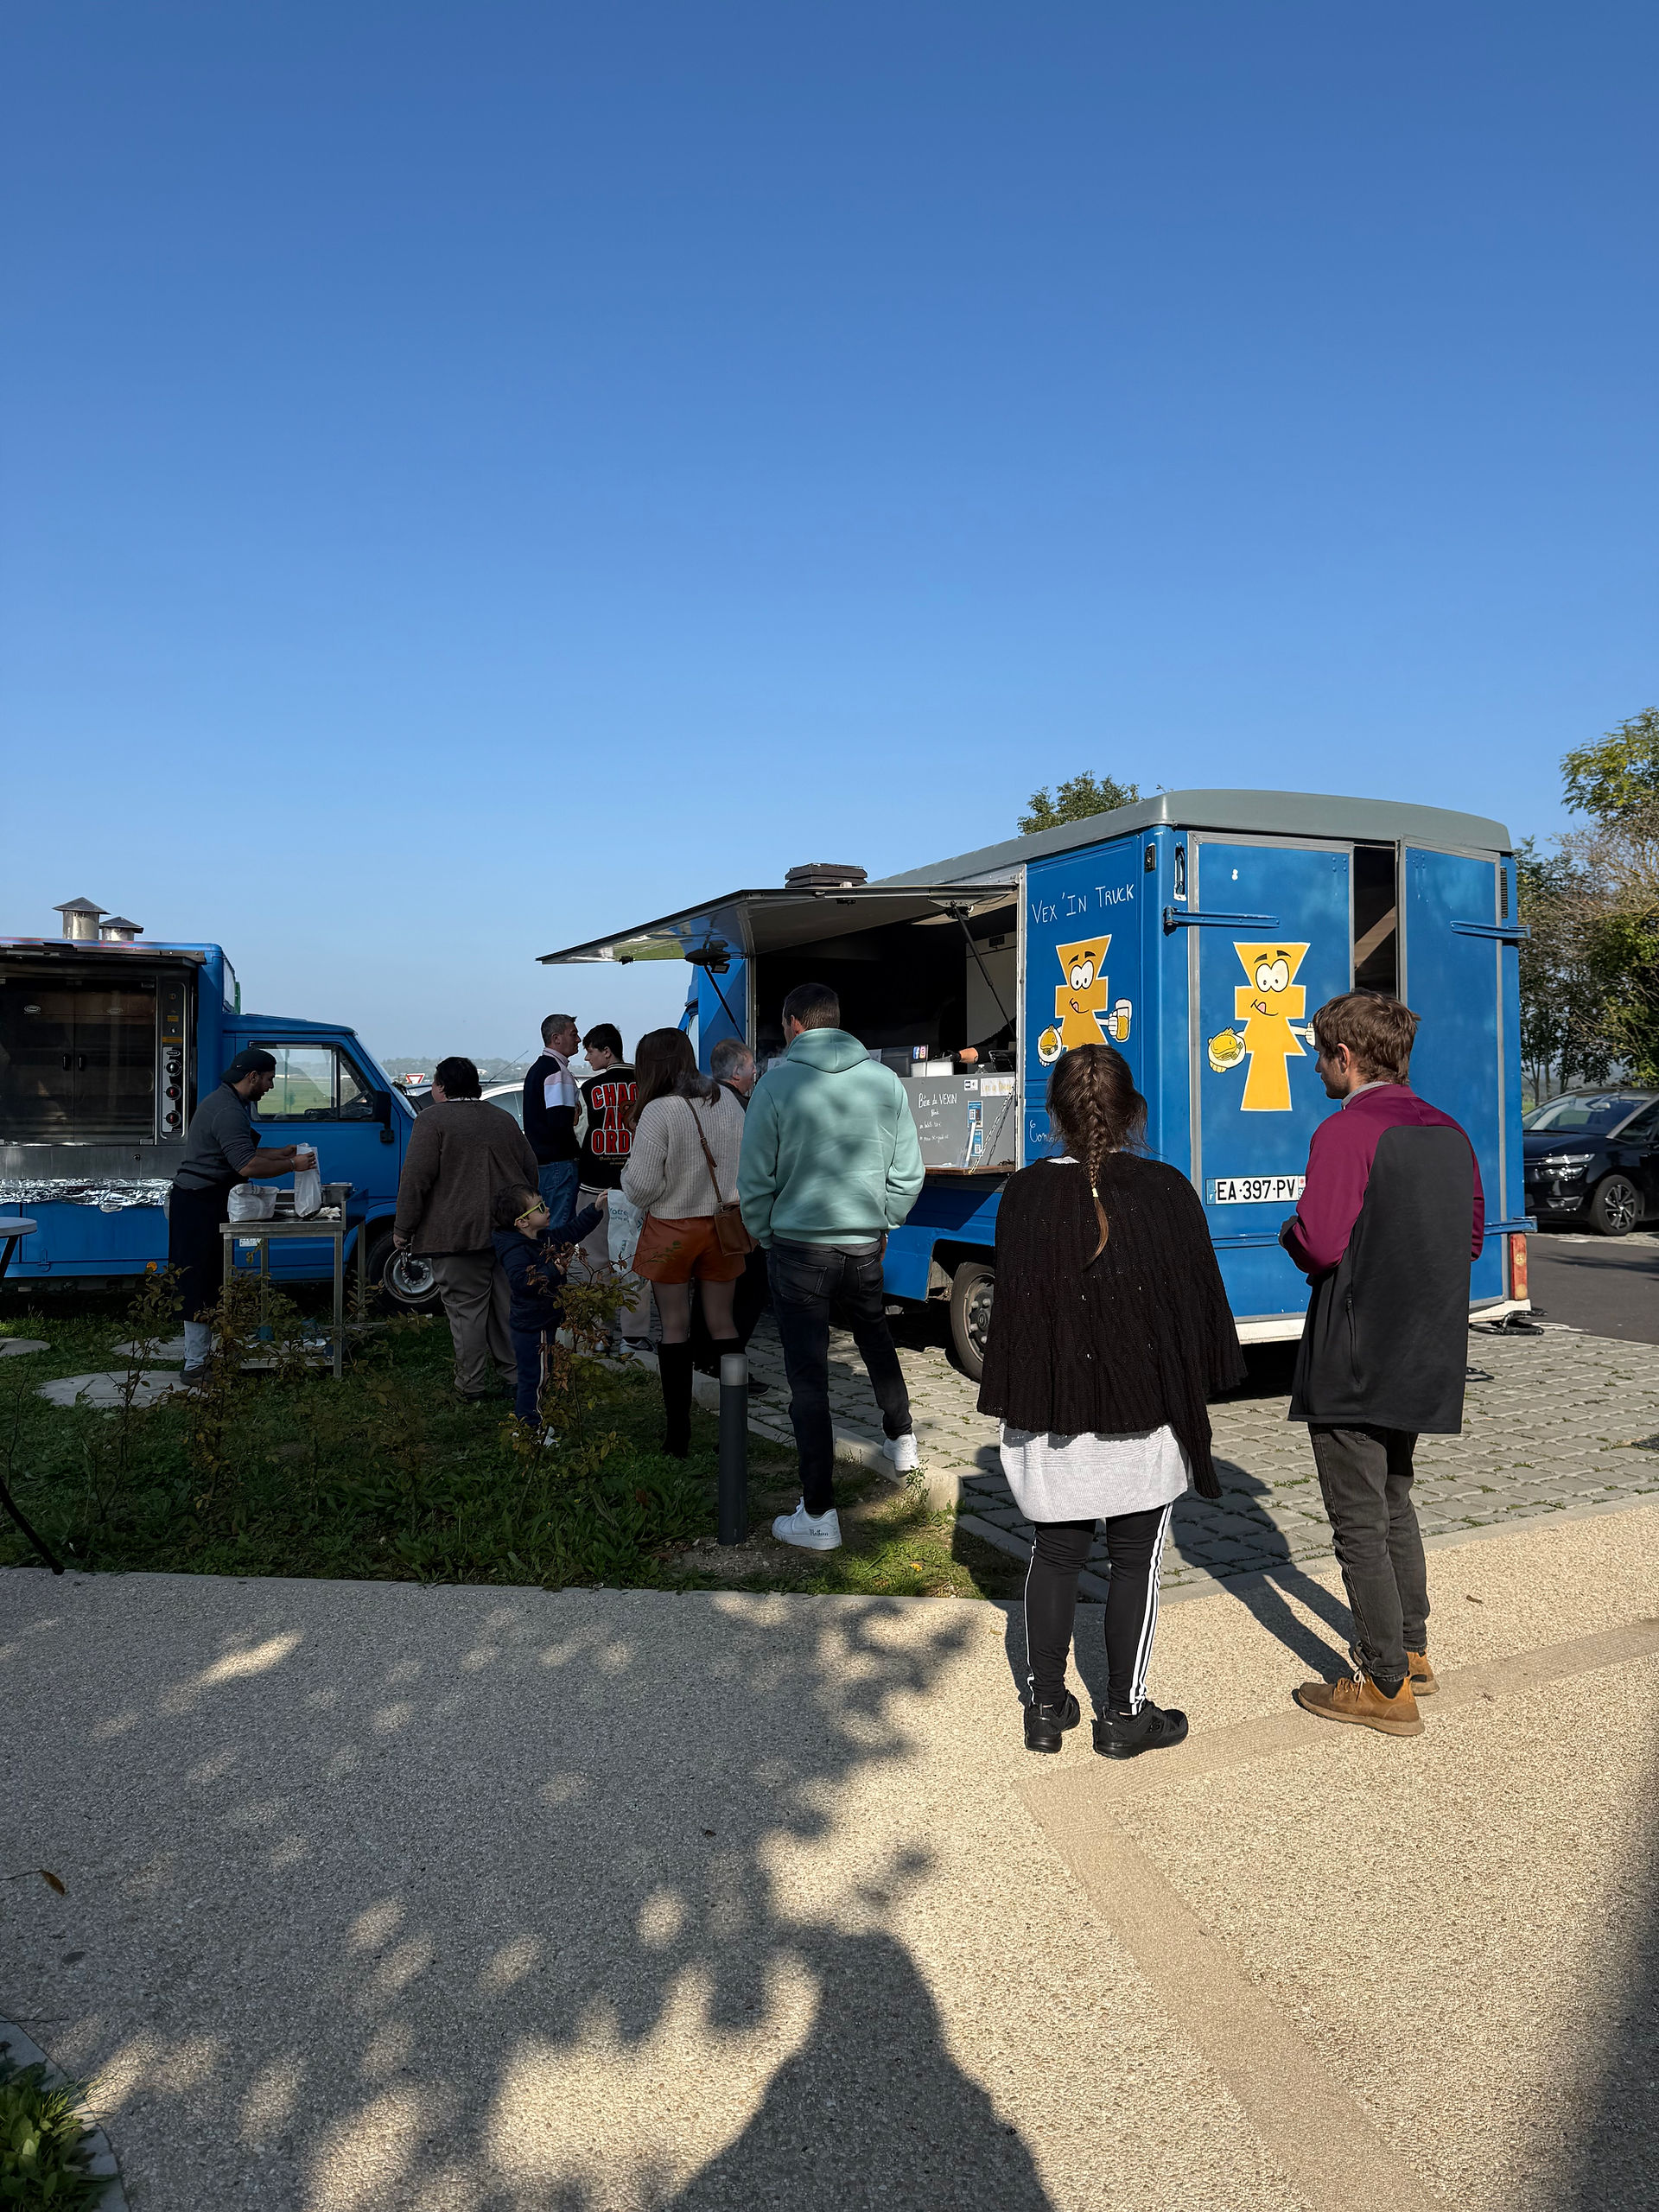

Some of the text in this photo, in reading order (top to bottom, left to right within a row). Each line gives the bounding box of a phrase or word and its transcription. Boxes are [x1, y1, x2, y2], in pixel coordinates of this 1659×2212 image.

[1031, 899, 1058, 925] VEX
[1095, 883, 1135, 908] TRUCK
[938, 1092, 957, 1105] VEXIN
[591, 1128, 638, 1155] ORD
